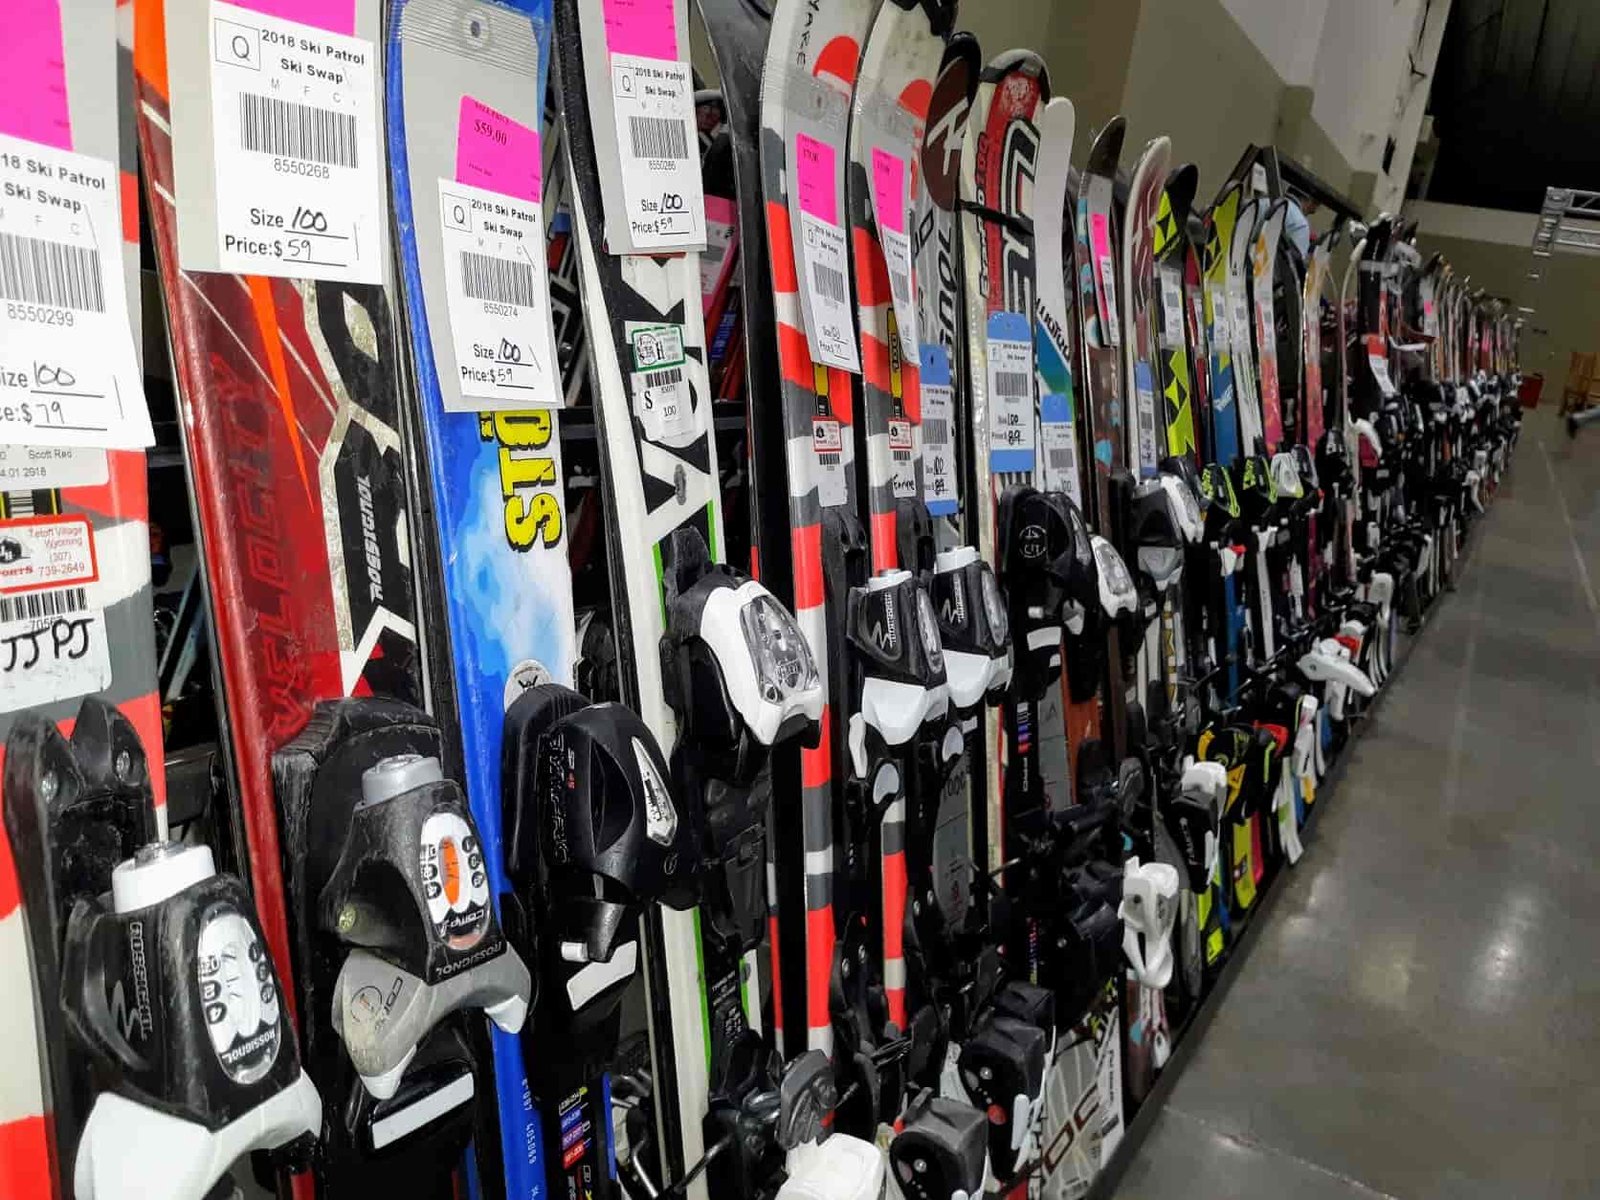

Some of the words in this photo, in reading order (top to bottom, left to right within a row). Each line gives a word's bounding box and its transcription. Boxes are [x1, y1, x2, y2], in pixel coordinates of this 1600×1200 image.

[231, 35, 250, 62] Q
[261, 29, 296, 48] 2018
[299, 39, 321, 55] Ski
[325, 45, 365, 65] Patrol
[280, 58, 303, 74] Ski
[306, 64, 344, 84] Swap
[622, 74, 631, 92] Q
[473, 118, 508, 146] $59.00
[26, 159, 52, 177] Ski
[58, 168, 105, 190] Patrol
[273, 157, 330, 179] 8550268
[4, 182, 31, 201] Ski
[37, 190, 81, 213] Swap
[641, 199, 658, 212] Size
[661, 192, 683, 213] 100
[250, 208, 284, 228] Size
[291, 206, 328, 232] 100
[452, 204, 466, 225] Q
[471, 199, 493, 212] 2018
[494, 204, 509, 216] Ski
[510, 207, 537, 223] Patrol
[661, 217, 673, 229] 59
[483, 221, 499, 233] Ski
[500, 226, 524, 239] Swap
[287, 239, 312, 261] 59
[7, 304, 74, 327] 8550299
[473, 344, 495, 360] Size
[498, 338, 521, 363] 100
[498, 368, 513, 382] 59
[357, 474, 383, 601] ROSSIGNOL
[436, 940, 502, 977] ROSSIGNOL
[129, 921, 154, 1042] ROSSIGNOL
[221, 1029, 278, 1063] ROSSIGNOL
